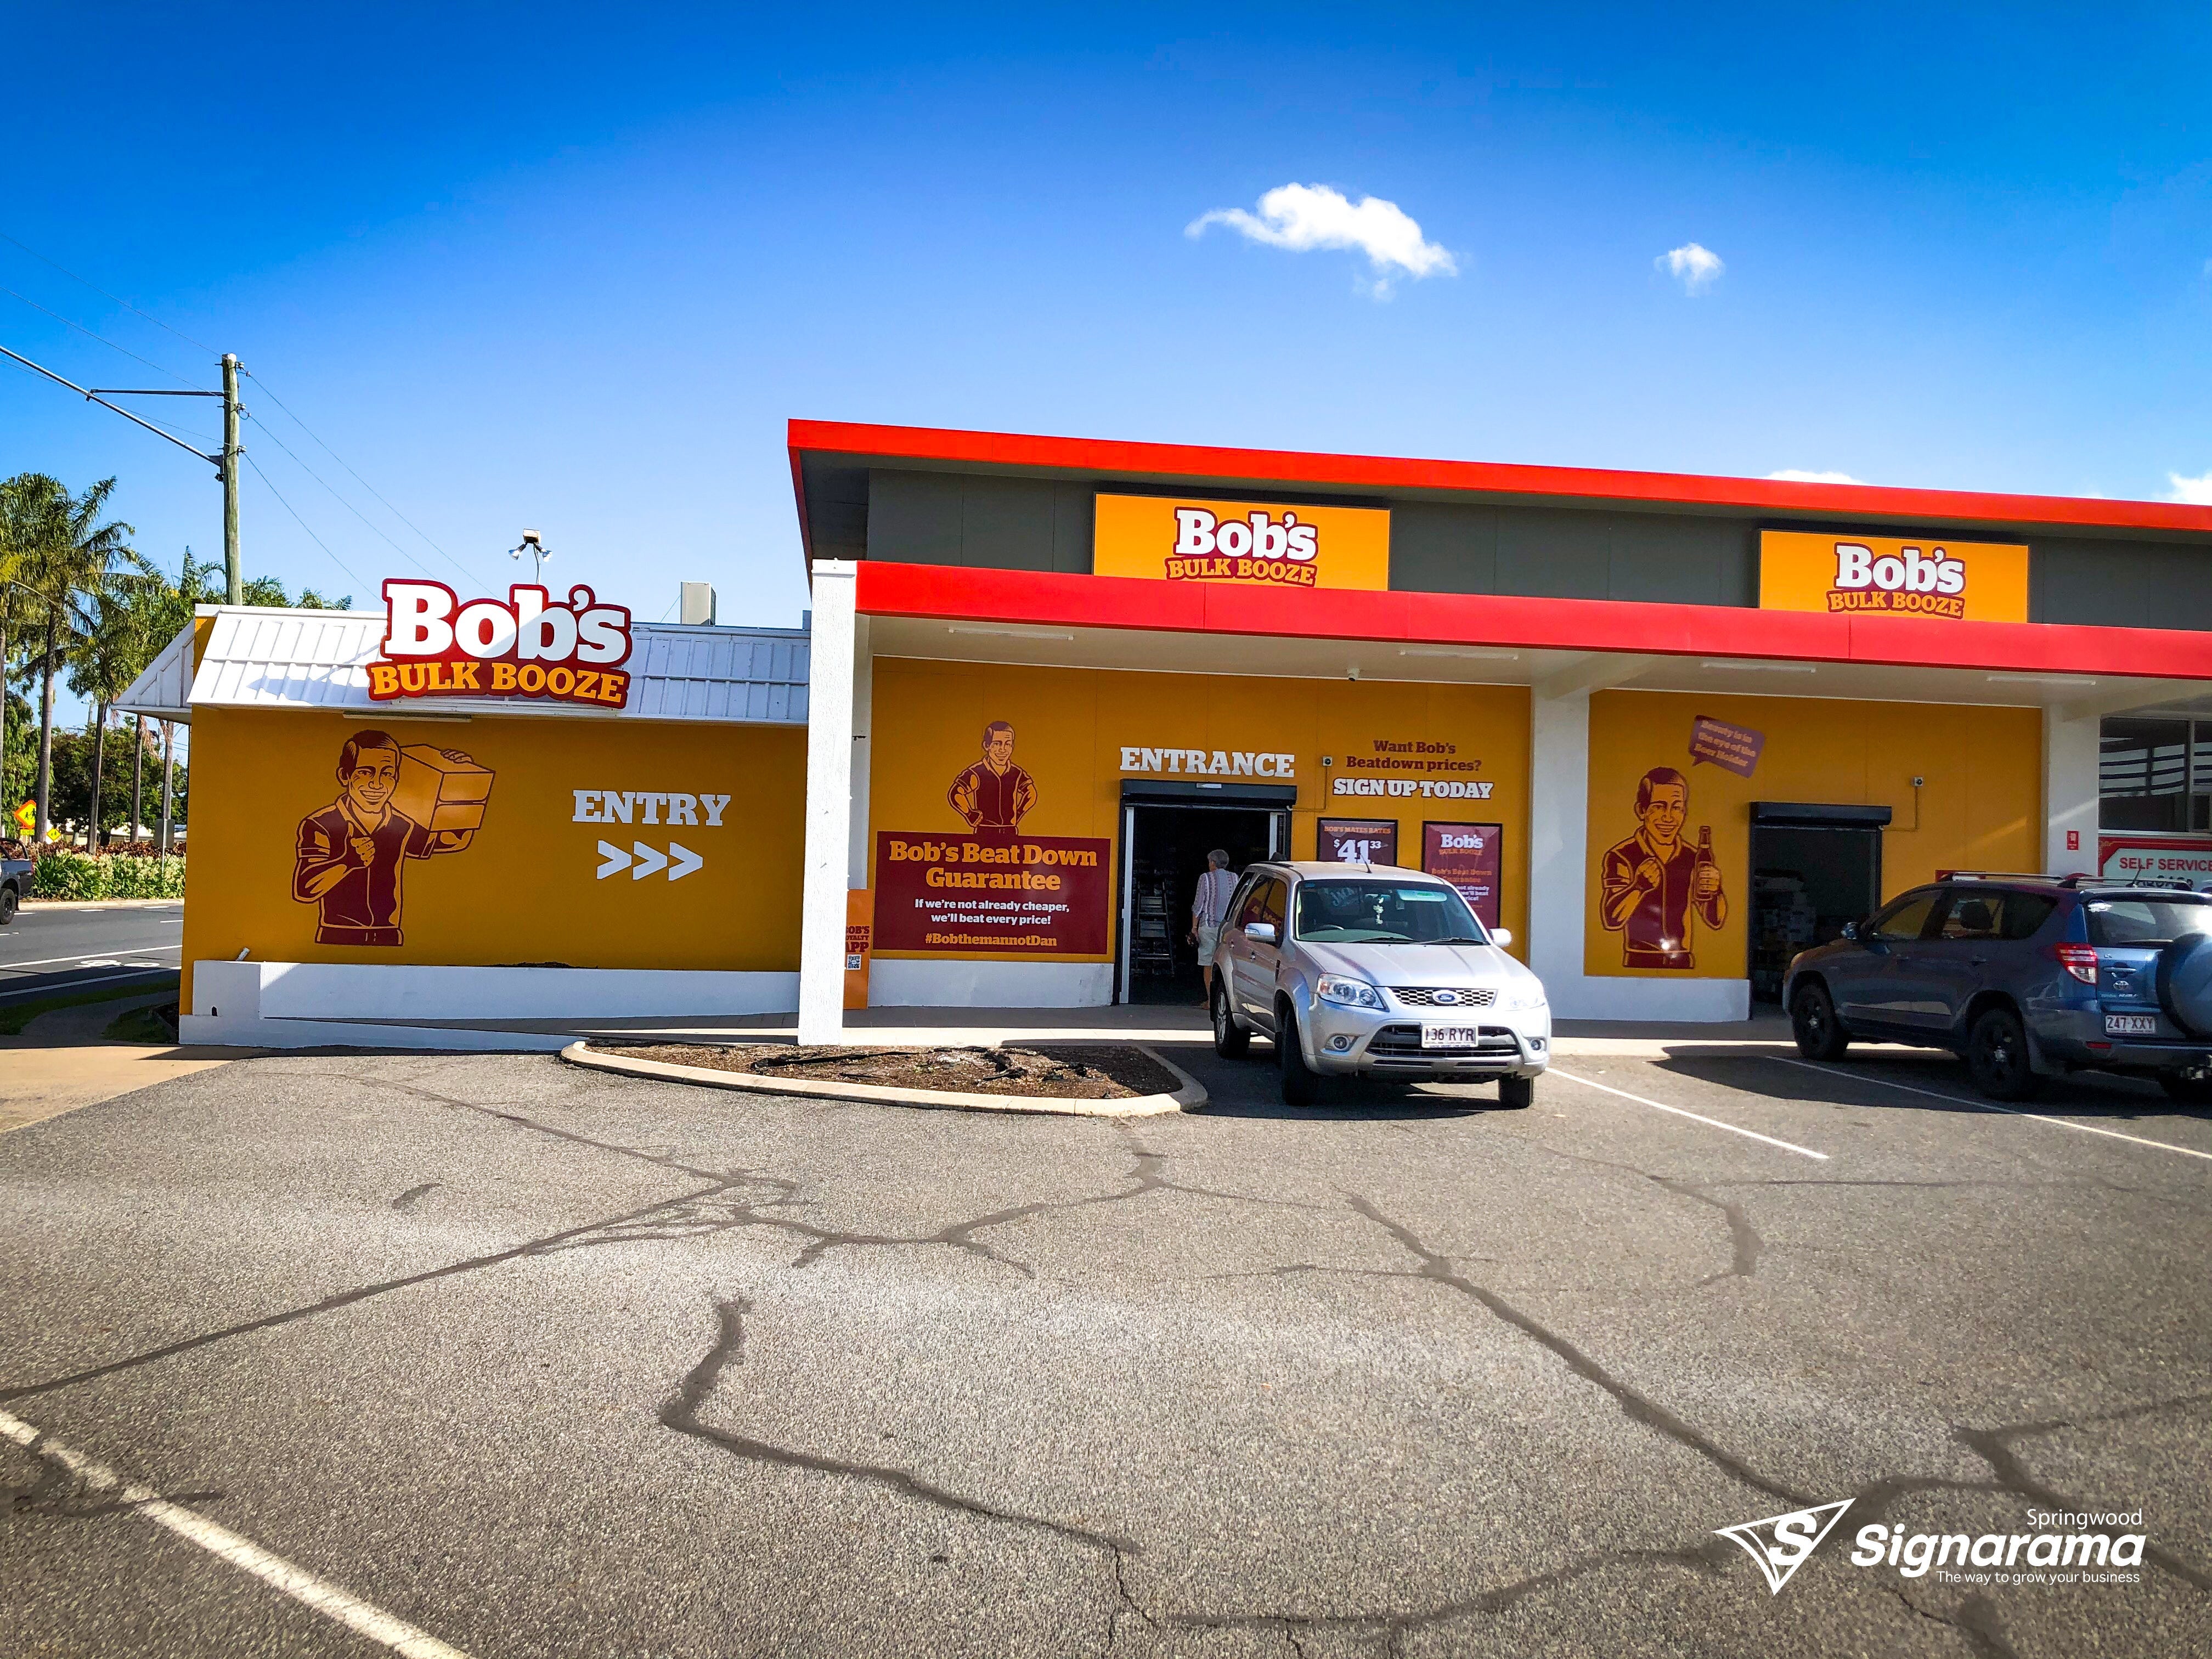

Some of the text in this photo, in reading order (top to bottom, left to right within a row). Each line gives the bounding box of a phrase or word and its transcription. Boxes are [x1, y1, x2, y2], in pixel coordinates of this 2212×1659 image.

[1176, 509, 1316, 561] Bob's
[1168, 558, 1315, 584] BULK BOOZE
[1835, 545, 1963, 593] Bob's
[1829, 591, 1962, 616] BULK BOOZE
[385, 583, 626, 663] Bob's
[371, 662, 625, 703] BULK BOOZE
[1374, 740, 1456, 754] Want Bob's
[1120, 747, 1295, 778] ENTRANCE
[1346, 755, 1482, 773] Beatdown prices?
[1334, 778, 1494, 799] SIGN UP TODAY
[572, 789, 731, 827] ENTRY
[1440, 834, 1483, 849] Bob's
[889, 841, 1097, 866] Bob's Beat Down
[2120, 857, 2154, 869] SELF
[926, 867, 1061, 890] Guarantee
[915, 898, 1070, 913] If we're not already cheaper,
[846, 926, 870, 934] OB'S
[931, 913, 1051, 926] we'll beat every price!
[925, 933, 1057, 947] #BobthemannotDan
